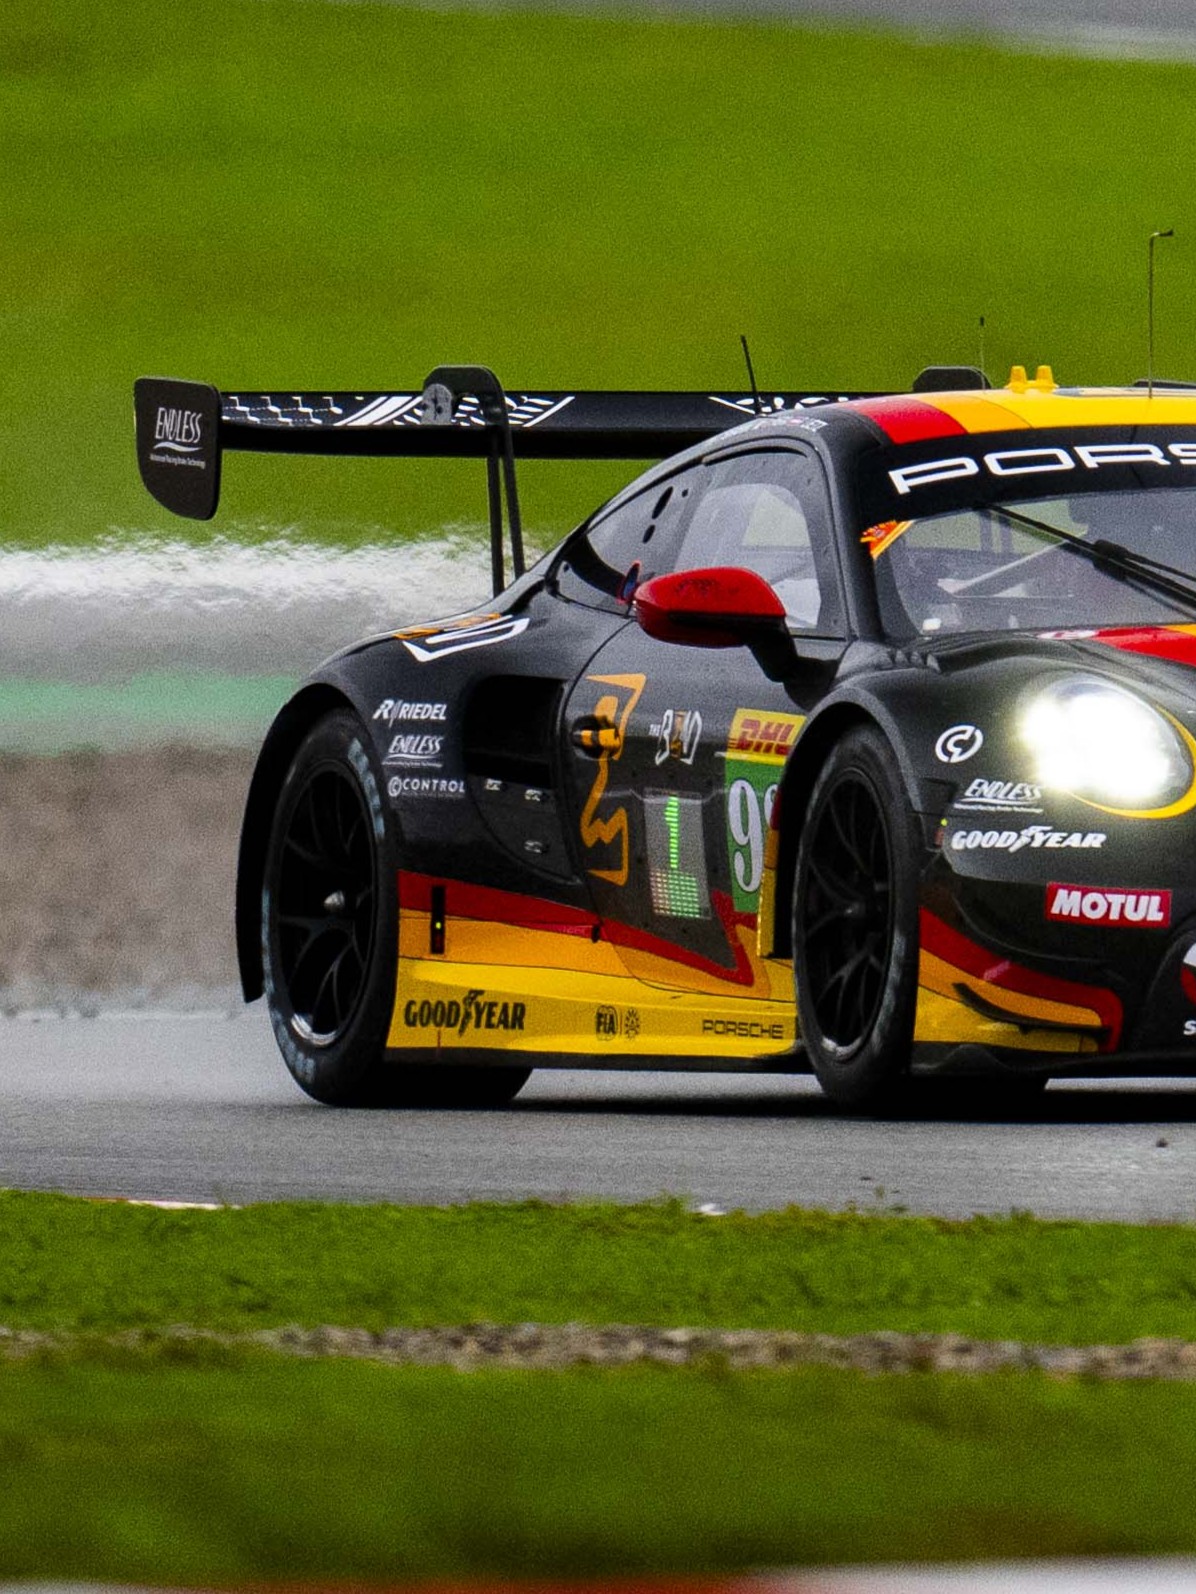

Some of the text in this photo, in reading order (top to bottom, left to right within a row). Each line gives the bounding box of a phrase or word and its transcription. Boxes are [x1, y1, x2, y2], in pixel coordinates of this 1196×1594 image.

[155, 406, 203, 444] ENDLESS
[398, 703, 448, 721] RIEDEL
[736, 717, 796, 757] DHL
[402, 778, 466, 793] CONTROL
[964, 778, 1042, 800] ENDLESS
[727, 778, 781, 892] 9
[951, 825, 1107, 853] GOODYEAR
[1050, 888, 1164, 922] MOTUL
[404, 989, 526, 1038] GOODYEAR
[702, 1019, 784, 1040] PORSCHE
